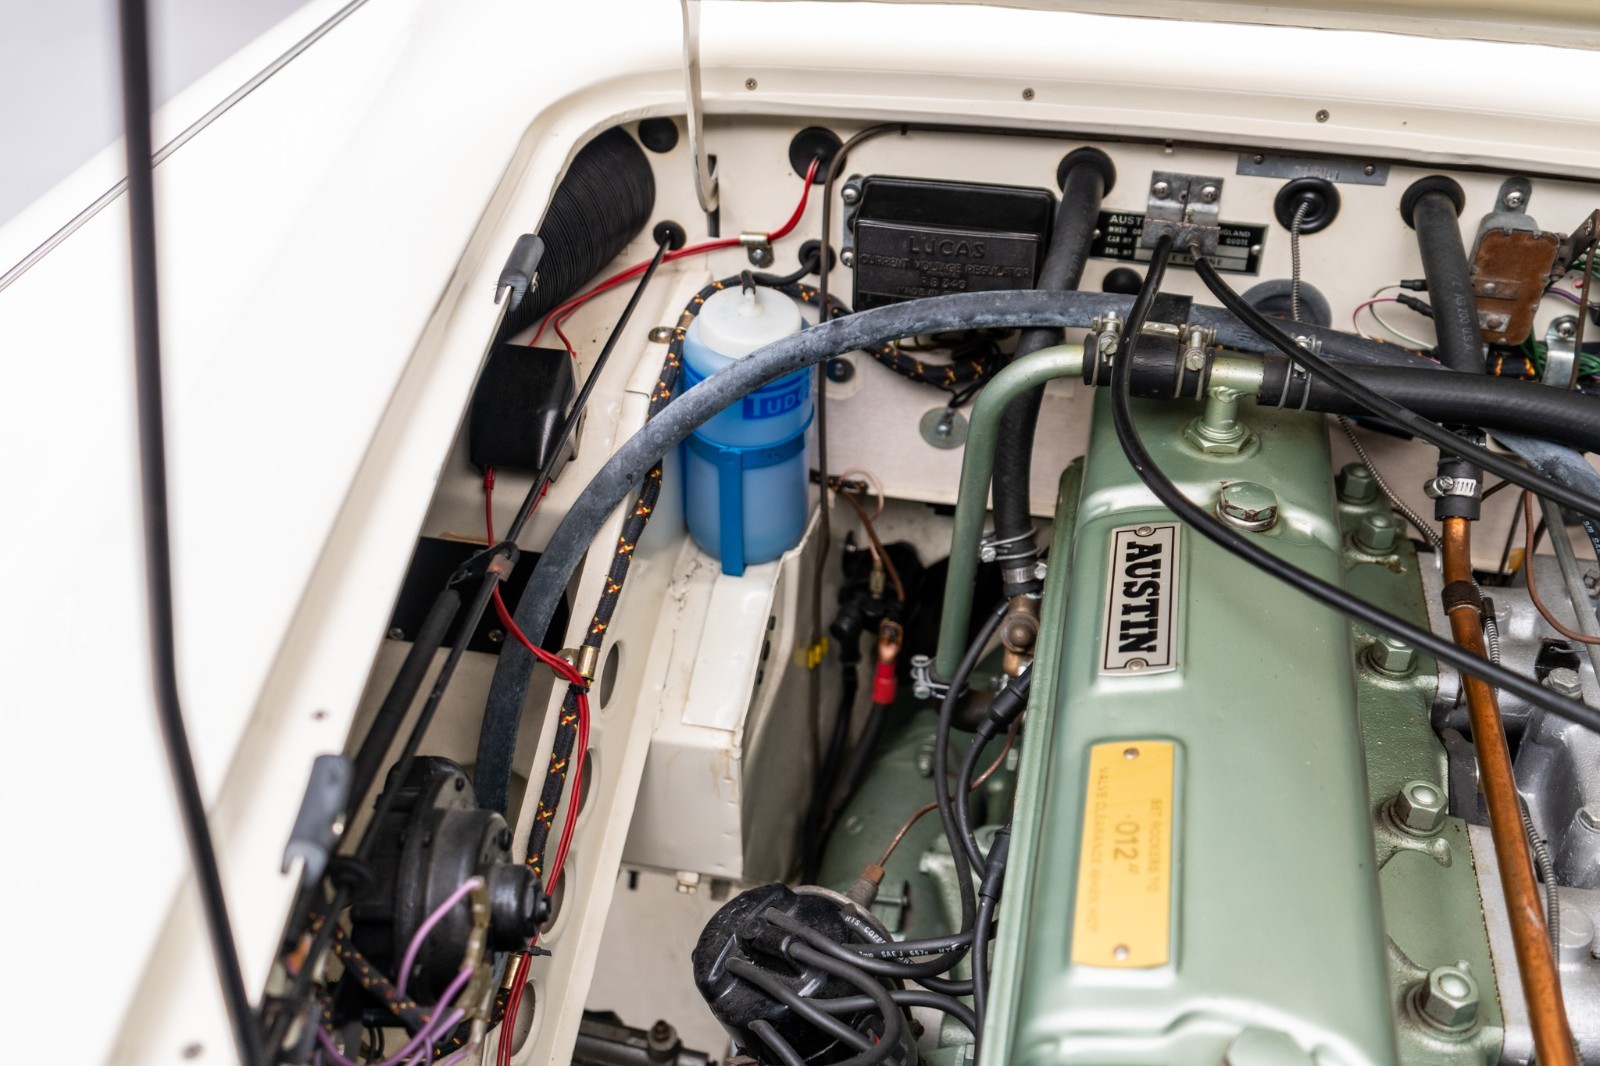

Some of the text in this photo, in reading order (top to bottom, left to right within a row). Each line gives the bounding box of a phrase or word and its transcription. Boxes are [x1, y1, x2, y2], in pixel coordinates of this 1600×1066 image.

[1110, 214, 1143, 226] AUST
[909, 235, 985, 259] LUCAS
[859, 253, 909, 268] CURRENT
[914, 259, 962, 274] VOLTAGE
[965, 264, 1031, 278] REGULATOR
[1118, 541, 1162, 653] AUSTIN
[1097, 767, 1109, 798] VALVE
[1091, 801, 1108, 865] CLEARANCE
[881, 950, 897, 958] SAE
